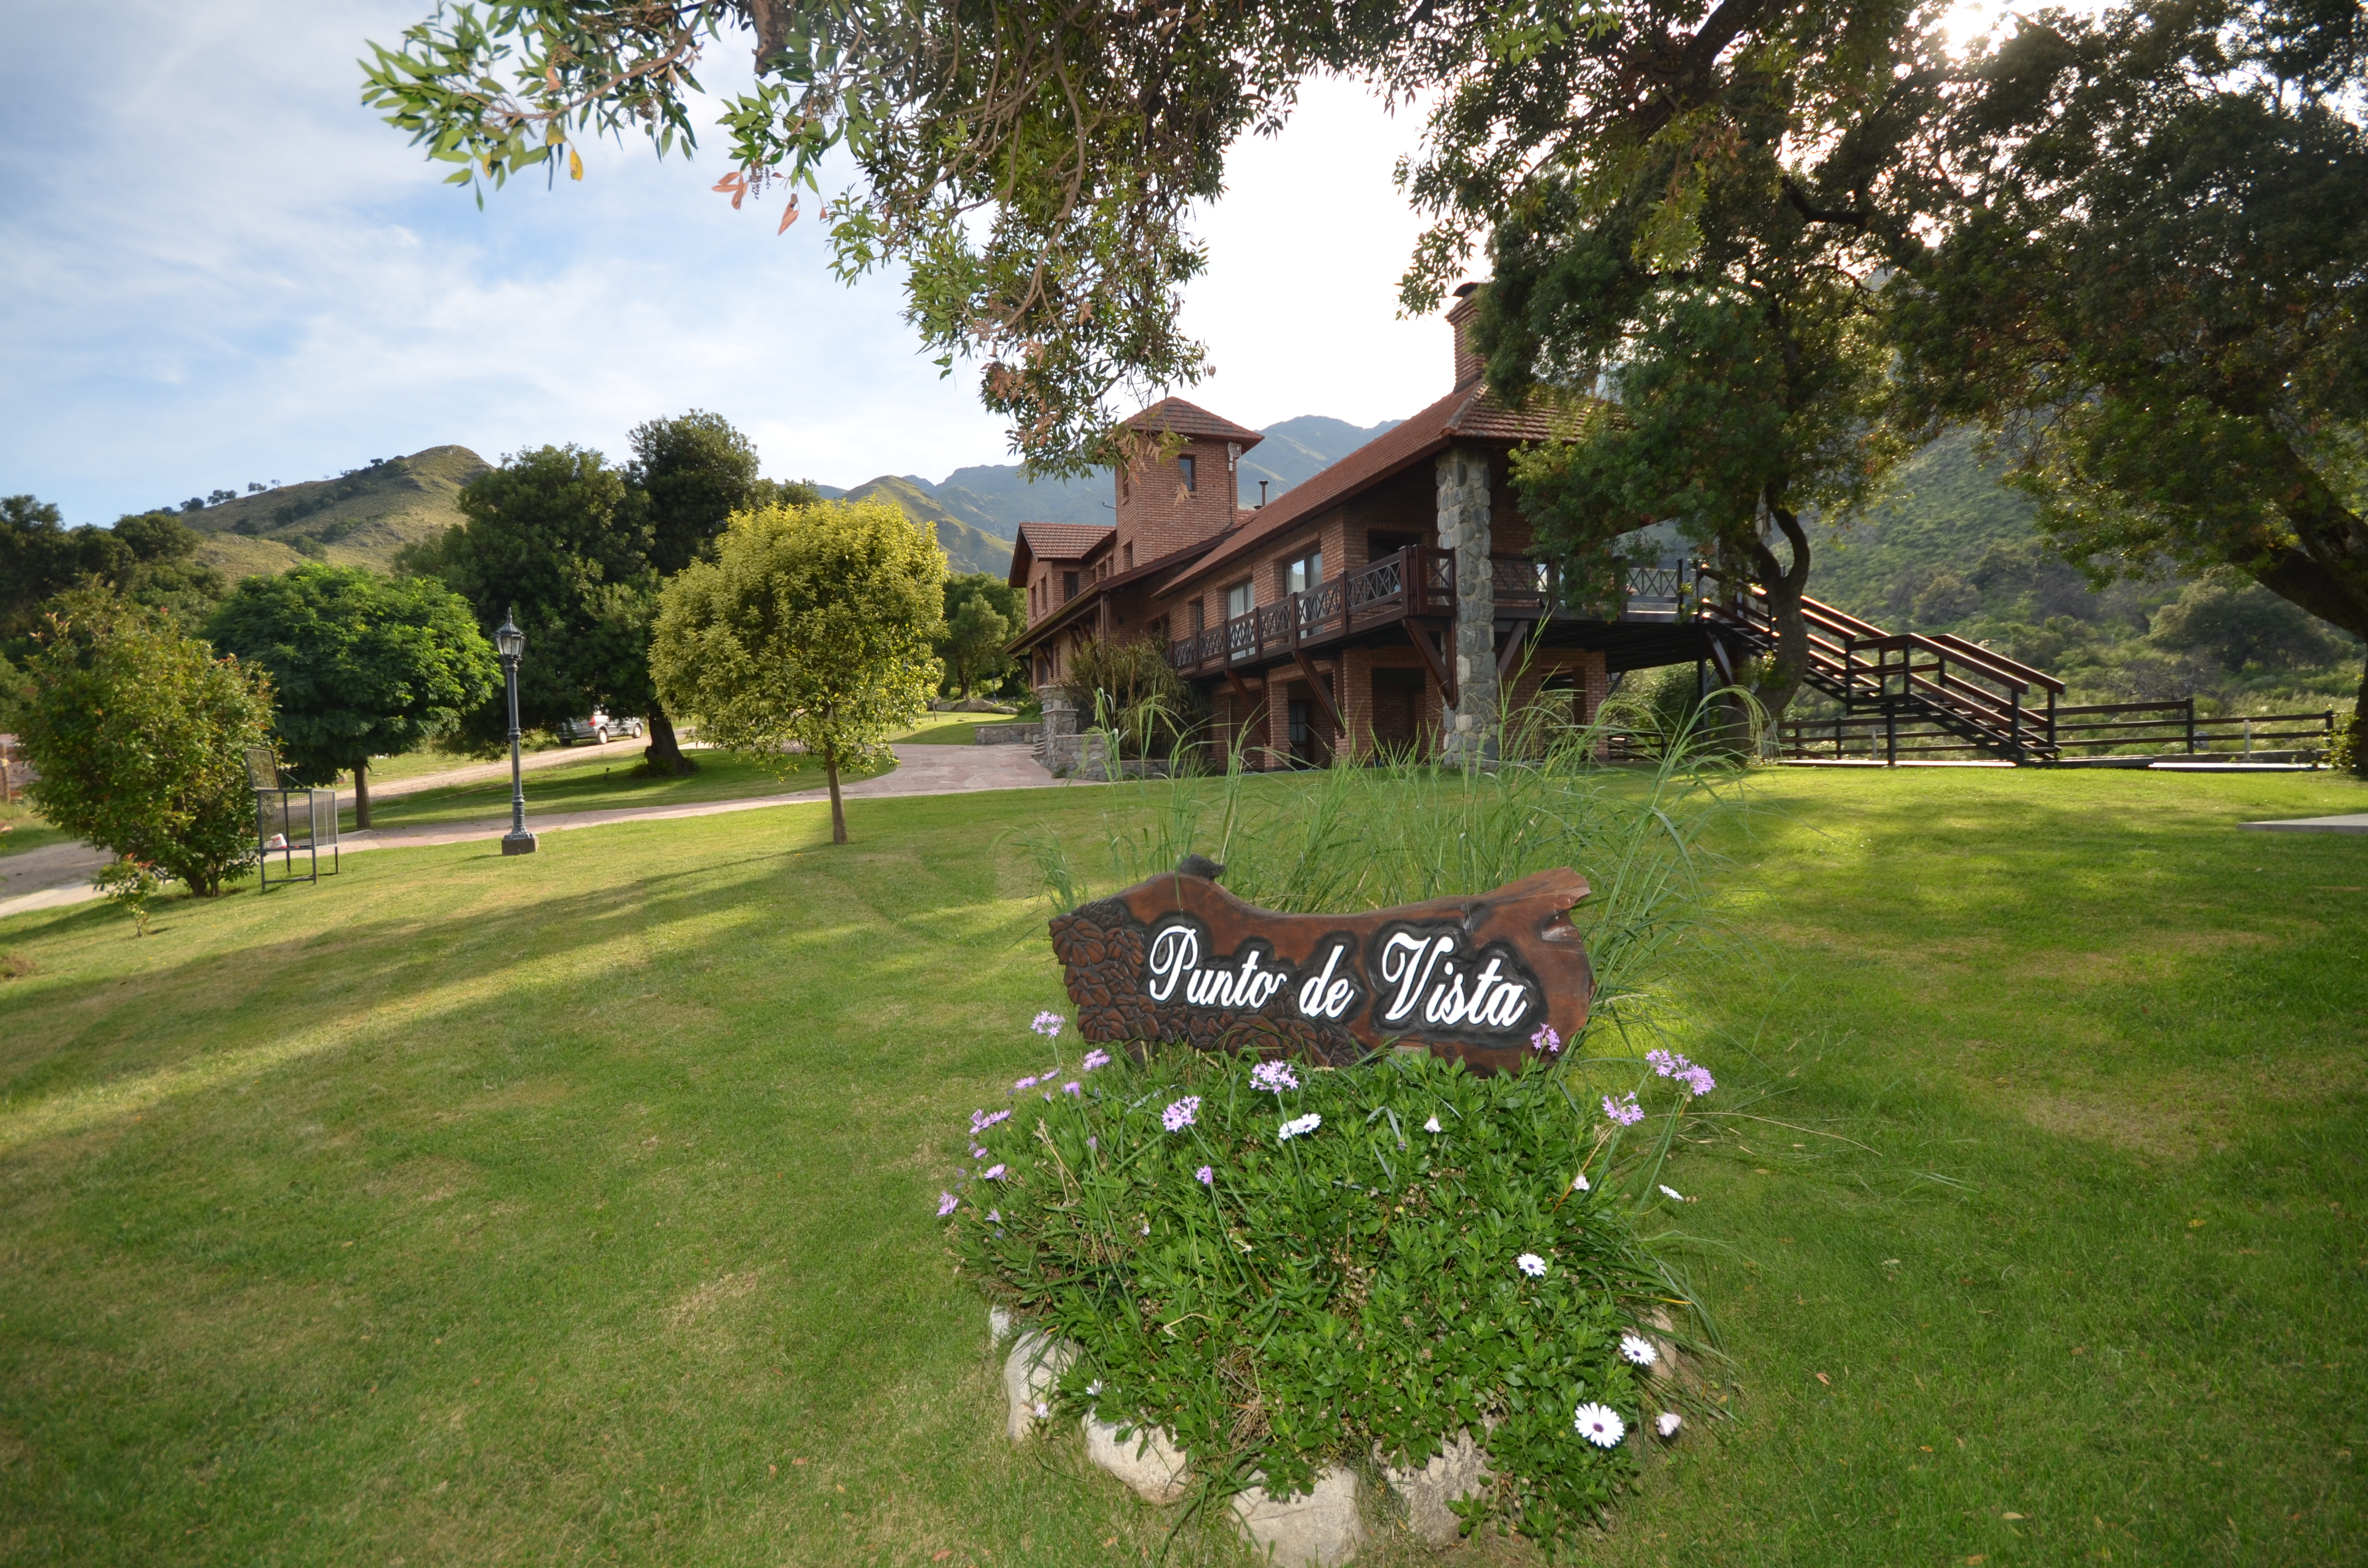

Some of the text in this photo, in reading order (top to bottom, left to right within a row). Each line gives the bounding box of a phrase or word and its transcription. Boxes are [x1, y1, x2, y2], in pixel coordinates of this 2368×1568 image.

[1149, 925, 1527, 1027] Punto de Vista
